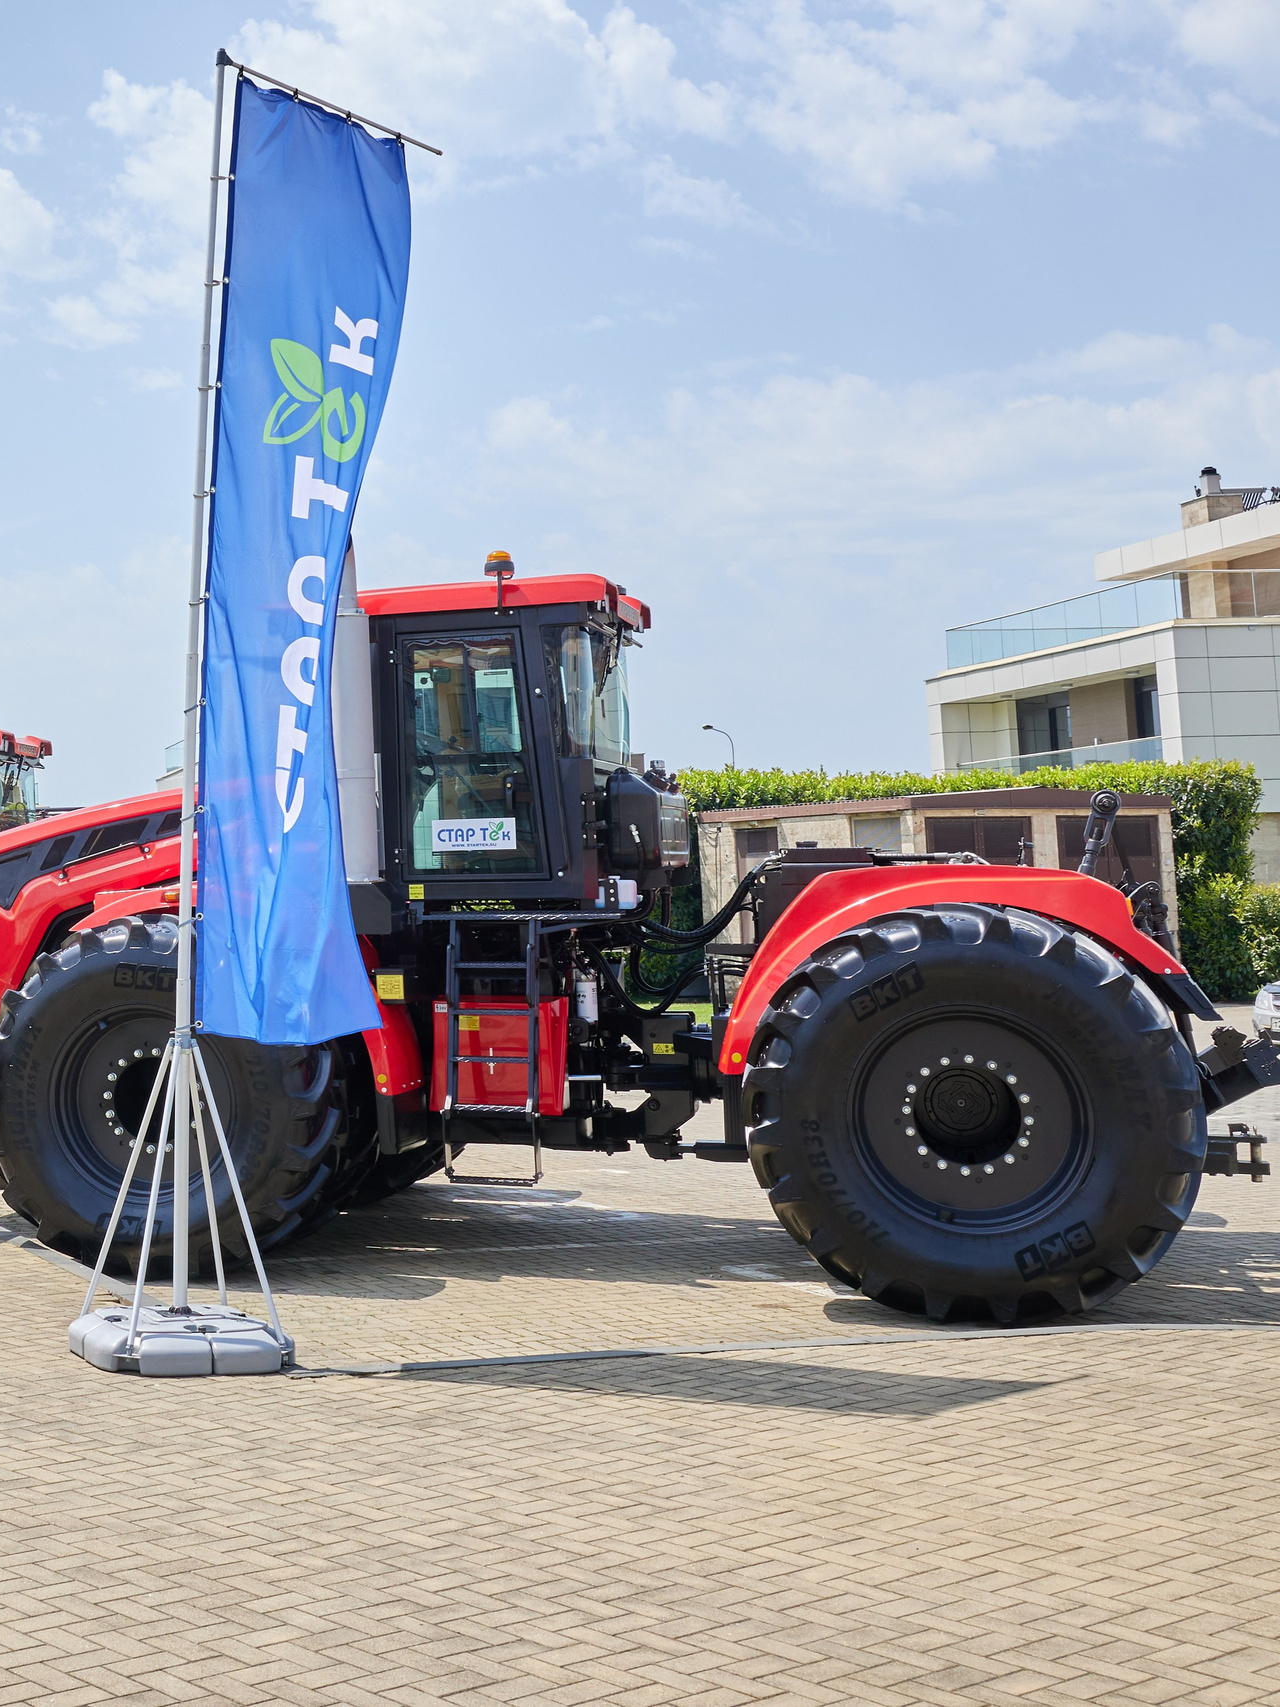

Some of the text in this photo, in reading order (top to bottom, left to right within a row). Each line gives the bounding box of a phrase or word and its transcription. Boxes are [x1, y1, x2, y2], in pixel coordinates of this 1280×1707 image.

[437, 828, 476, 842] СТАР
[115, 965, 177, 990] BKT
[850, 964, 921, 1019] BKT
